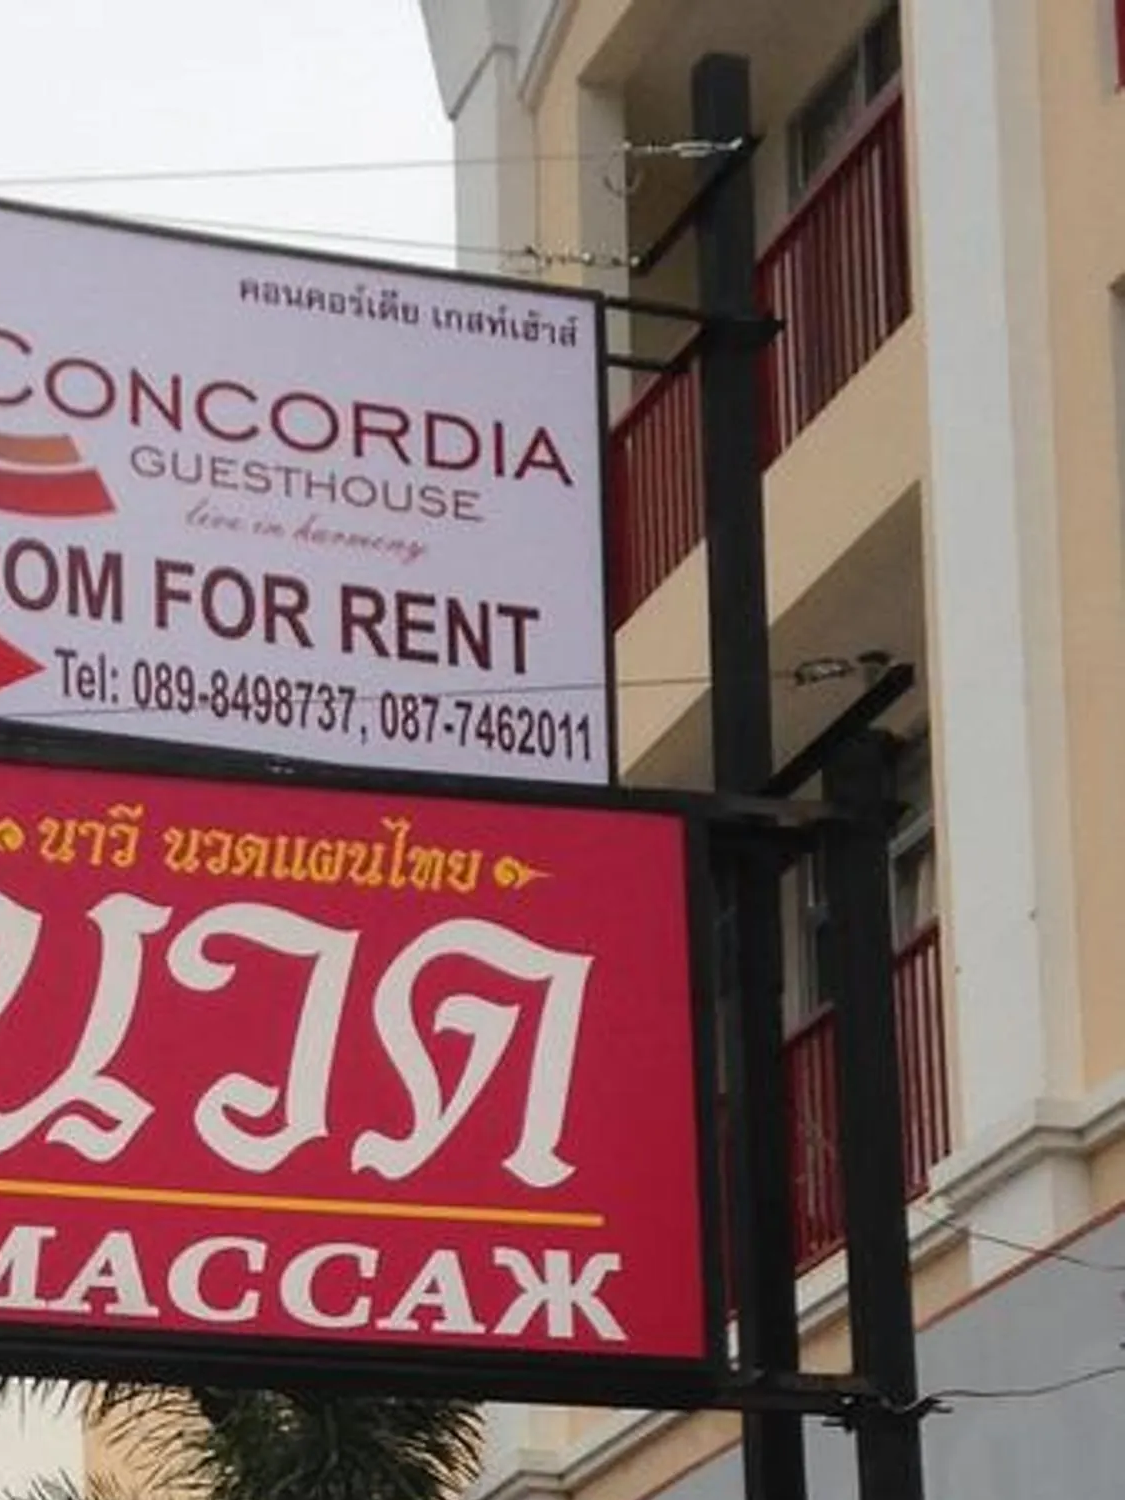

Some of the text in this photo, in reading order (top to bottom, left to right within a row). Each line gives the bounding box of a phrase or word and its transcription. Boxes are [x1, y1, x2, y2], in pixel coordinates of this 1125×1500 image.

[130, 444, 485, 523] GUESTHOUSE
[185, 497, 429, 566] live in harmony
[155, 557, 314, 650] FOR
[341, 584, 540, 677] RENT
[54, 648, 592, 762] Tel: 089-8498737, 087-7462011
[37, 803, 145, 868] นาวี
